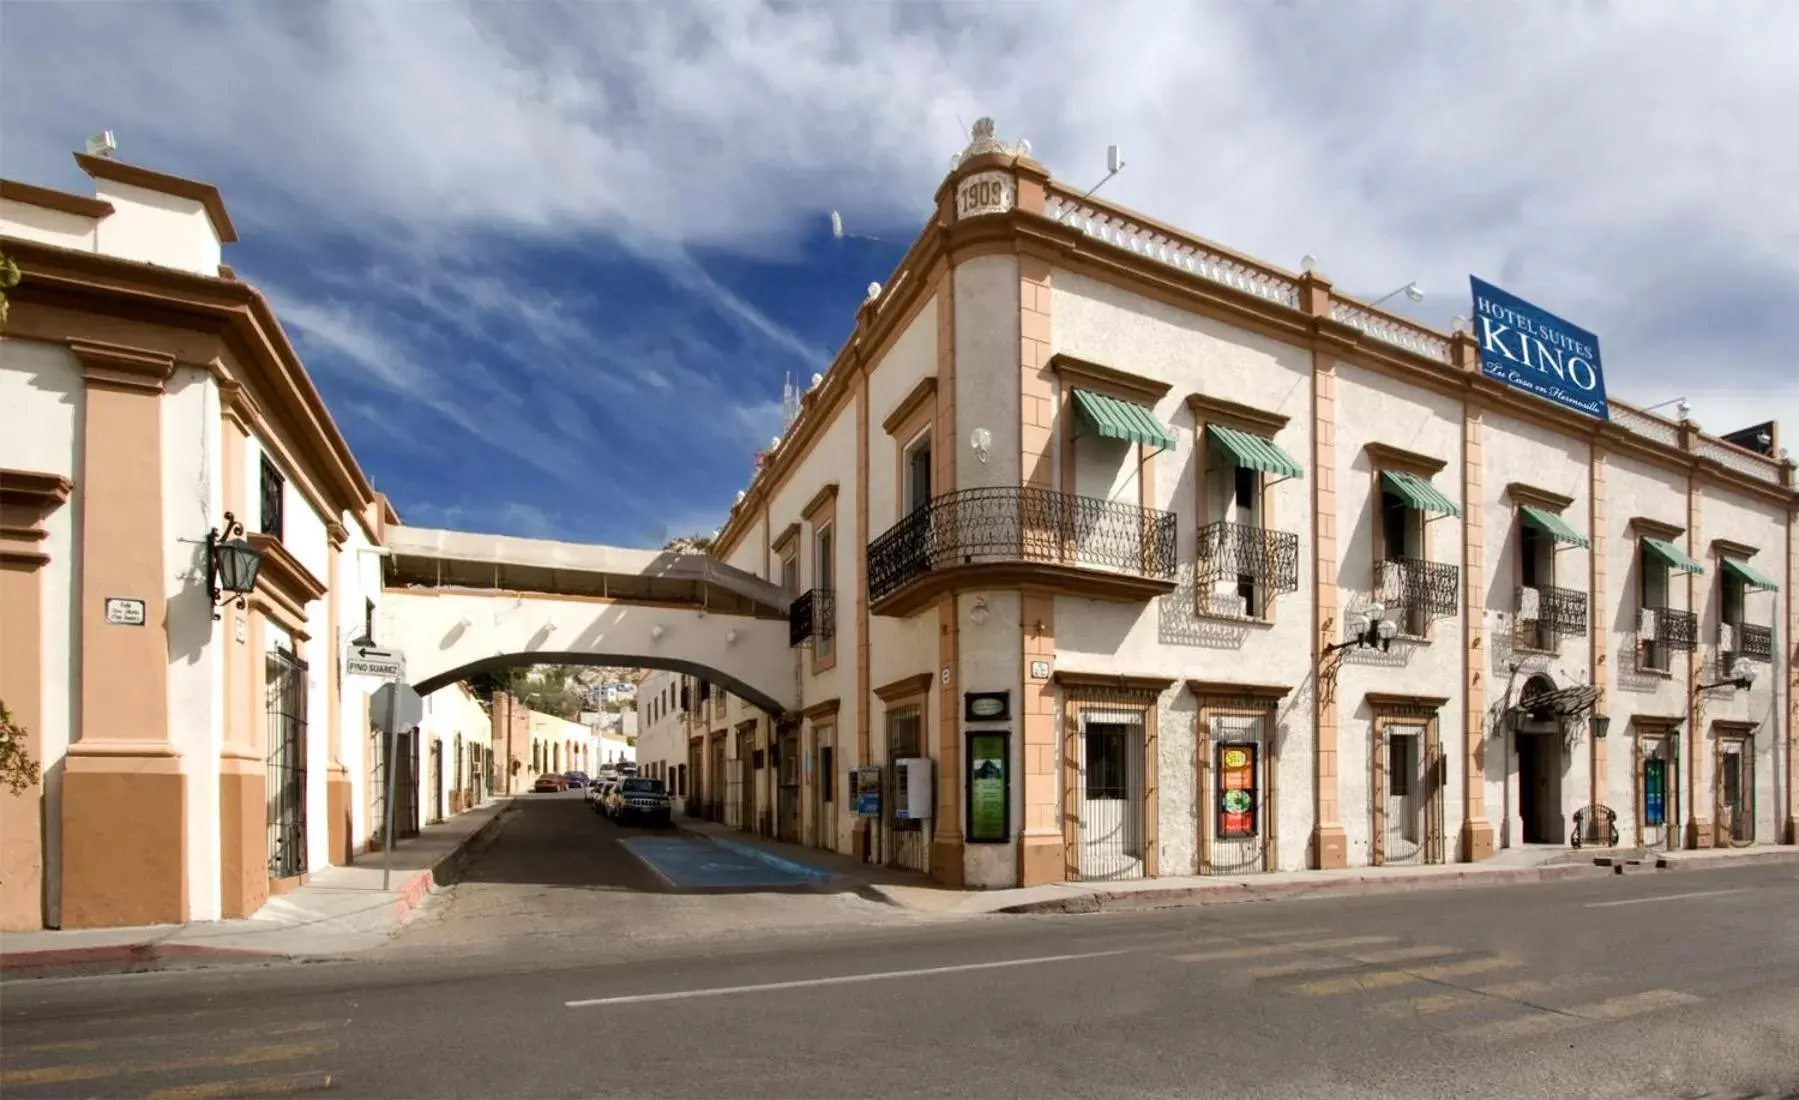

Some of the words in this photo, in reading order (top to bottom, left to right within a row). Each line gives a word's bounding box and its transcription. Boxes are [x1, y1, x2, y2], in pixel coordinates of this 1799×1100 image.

[962, 180, 1002, 213] 1909
[1478, 297, 1538, 335] HOTEL
[1540, 323, 1593, 360] SUITES
[1480, 314, 1597, 391] KINO
[1484, 361, 1506, 378] Tu
[1508, 369, 1533, 388] Casa
[1534, 385, 1547, 394] en
[1549, 386, 1600, 413] Hermosillo
[369, 663, 398, 674] SUAREZ
